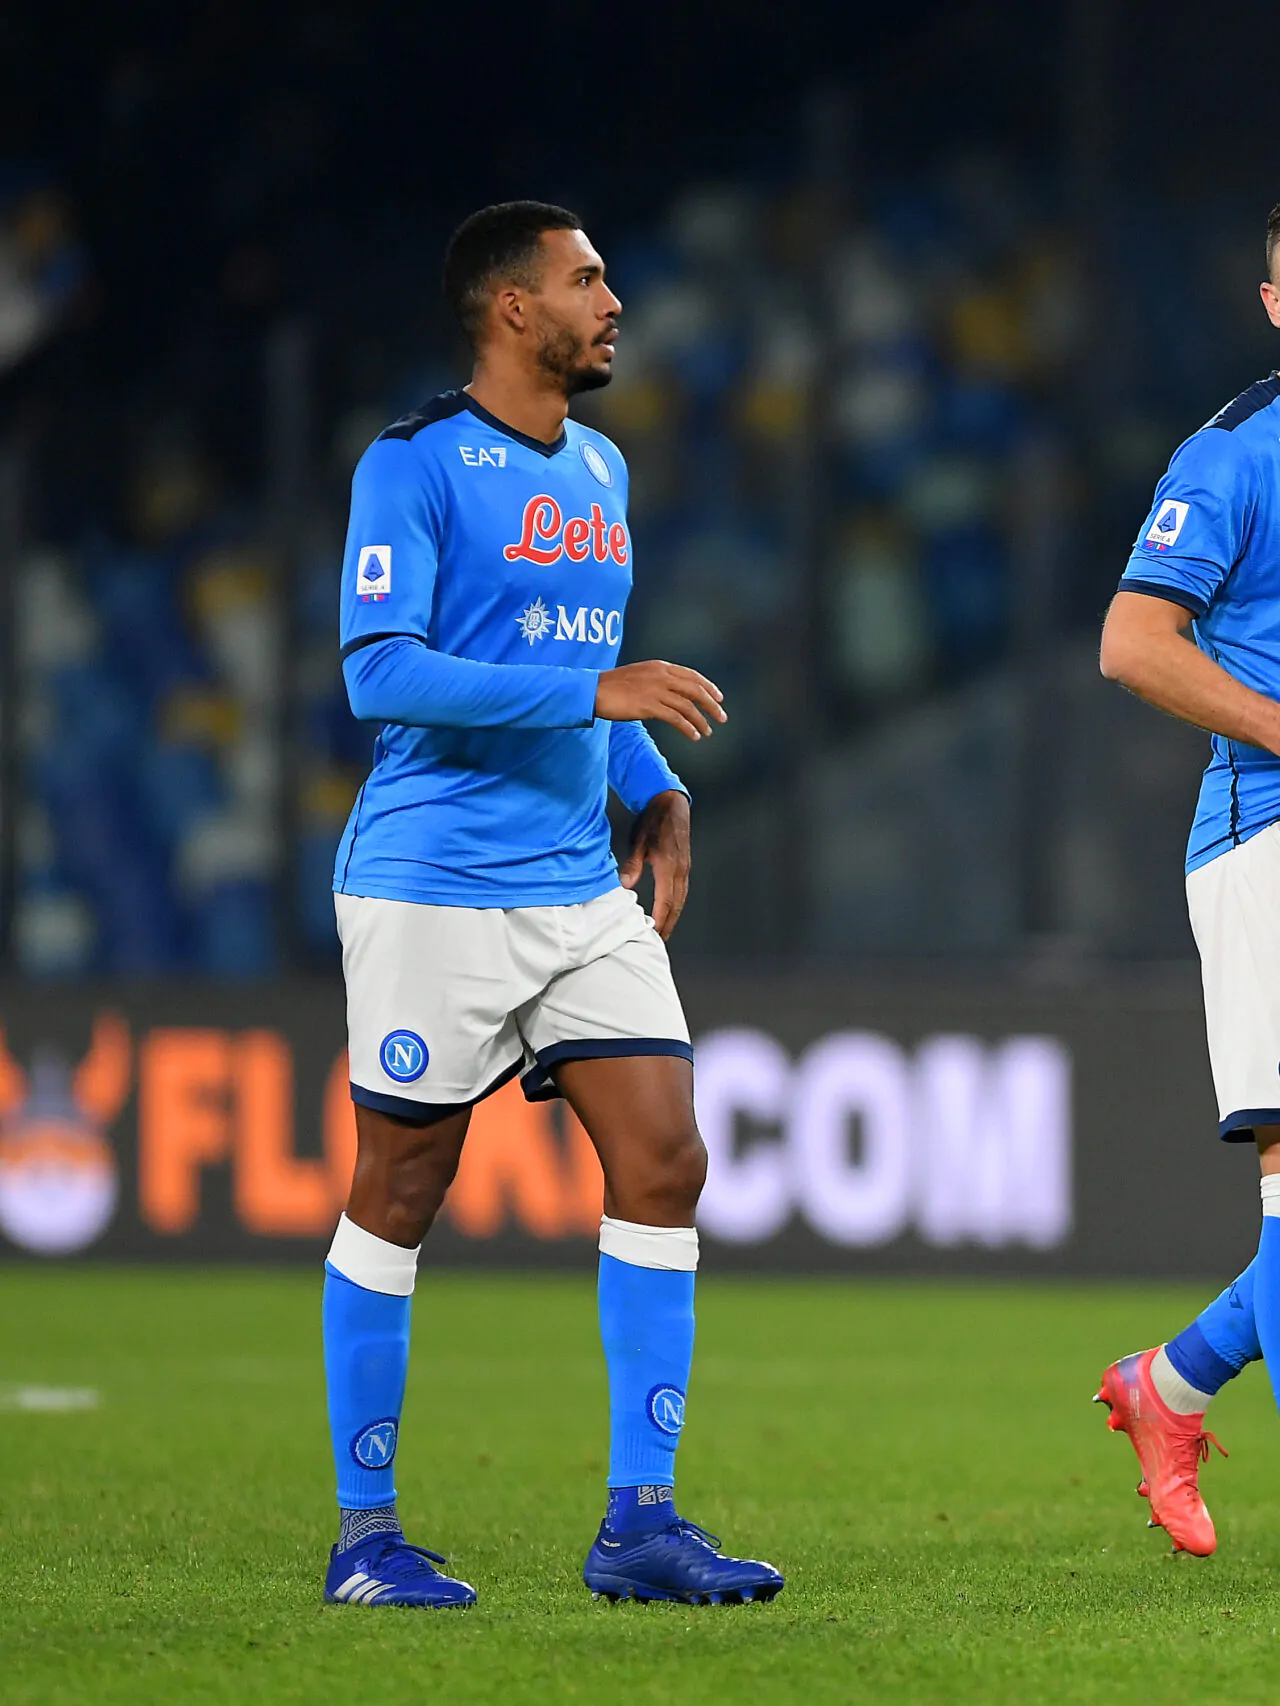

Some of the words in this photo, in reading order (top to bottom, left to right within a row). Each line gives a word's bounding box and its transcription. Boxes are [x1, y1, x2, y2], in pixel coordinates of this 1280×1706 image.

[458, 446, 507, 468] EA7
[502, 493, 629, 566] Lete
[553, 604, 621, 646] MSC
[392, 1043, 415, 1070] N
[661, 1396, 682, 1426] N
[365, 1431, 392, 1460] N
